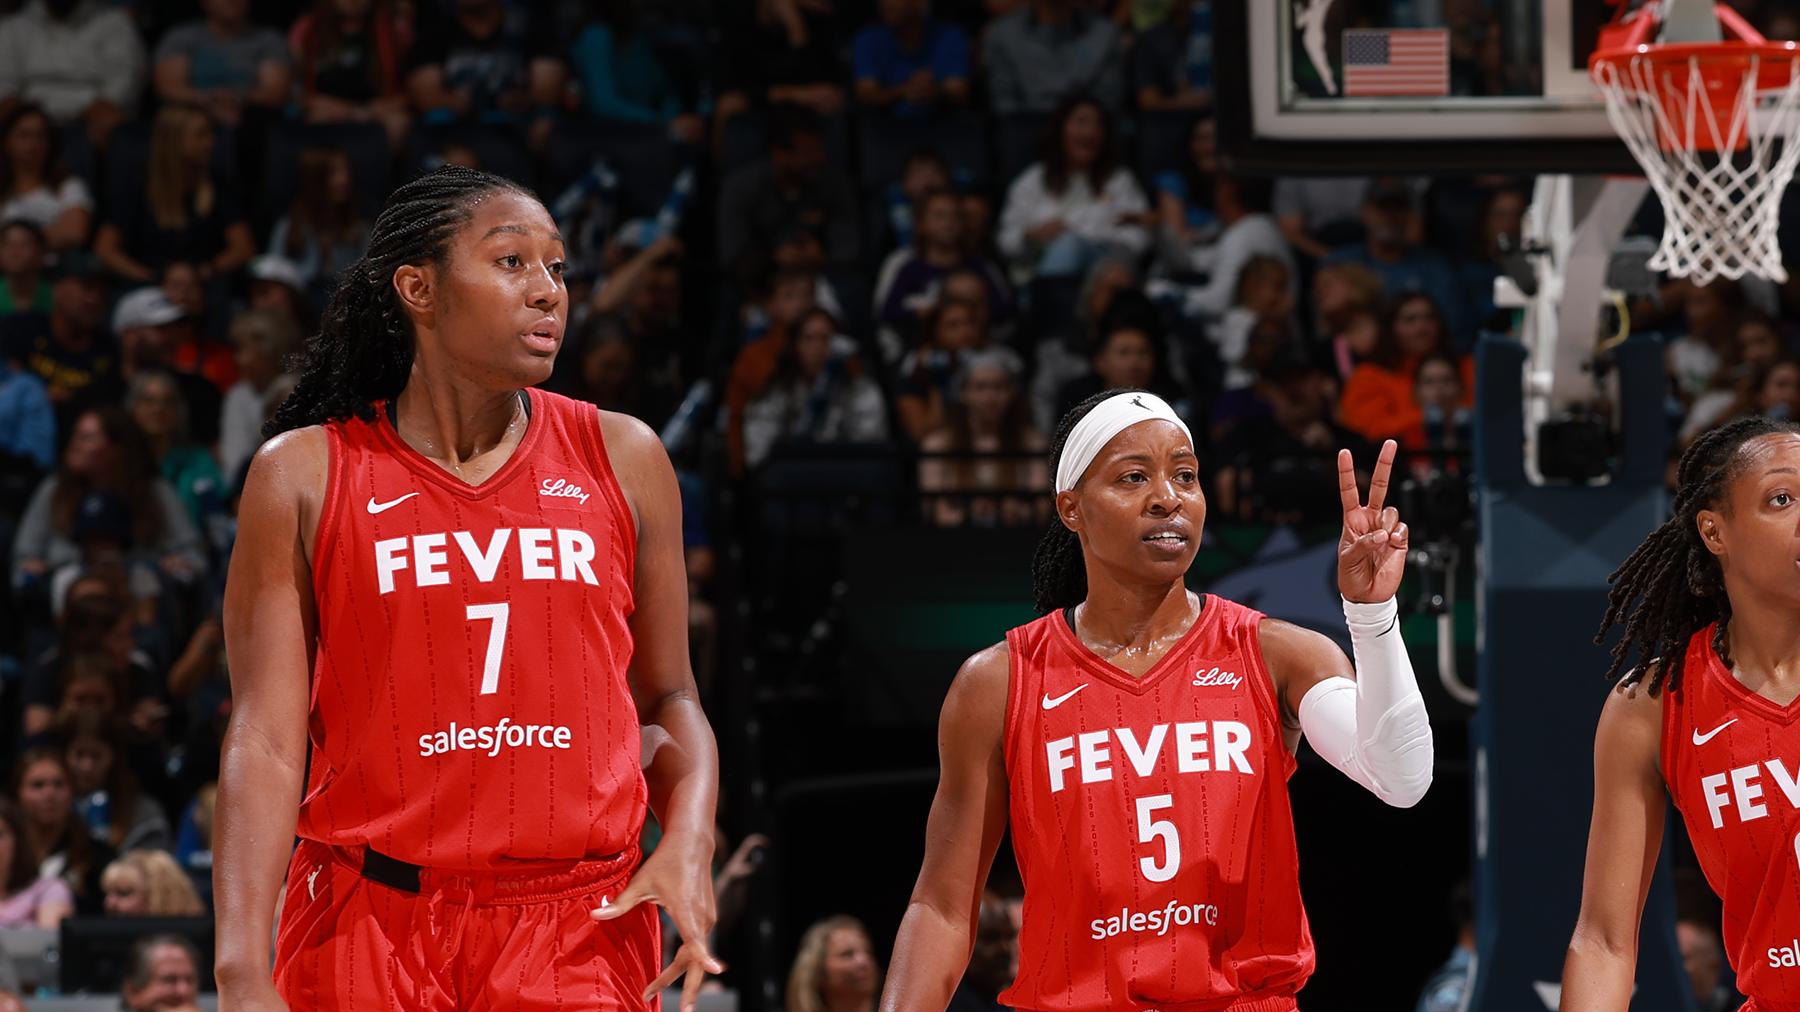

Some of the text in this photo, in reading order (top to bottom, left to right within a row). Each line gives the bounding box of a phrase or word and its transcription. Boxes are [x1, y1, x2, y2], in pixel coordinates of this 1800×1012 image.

[539, 478, 591, 505] Lilly
[374, 527, 600, 595] FEVER
[465, 602, 510, 695] 7
[1192, 667, 1243, 691] Lilly
[419, 717, 572, 757] salesforce
[1045, 720, 1254, 793] FEVER
[1135, 793, 1181, 883] 5
[1091, 899, 1218, 940] salesforce
